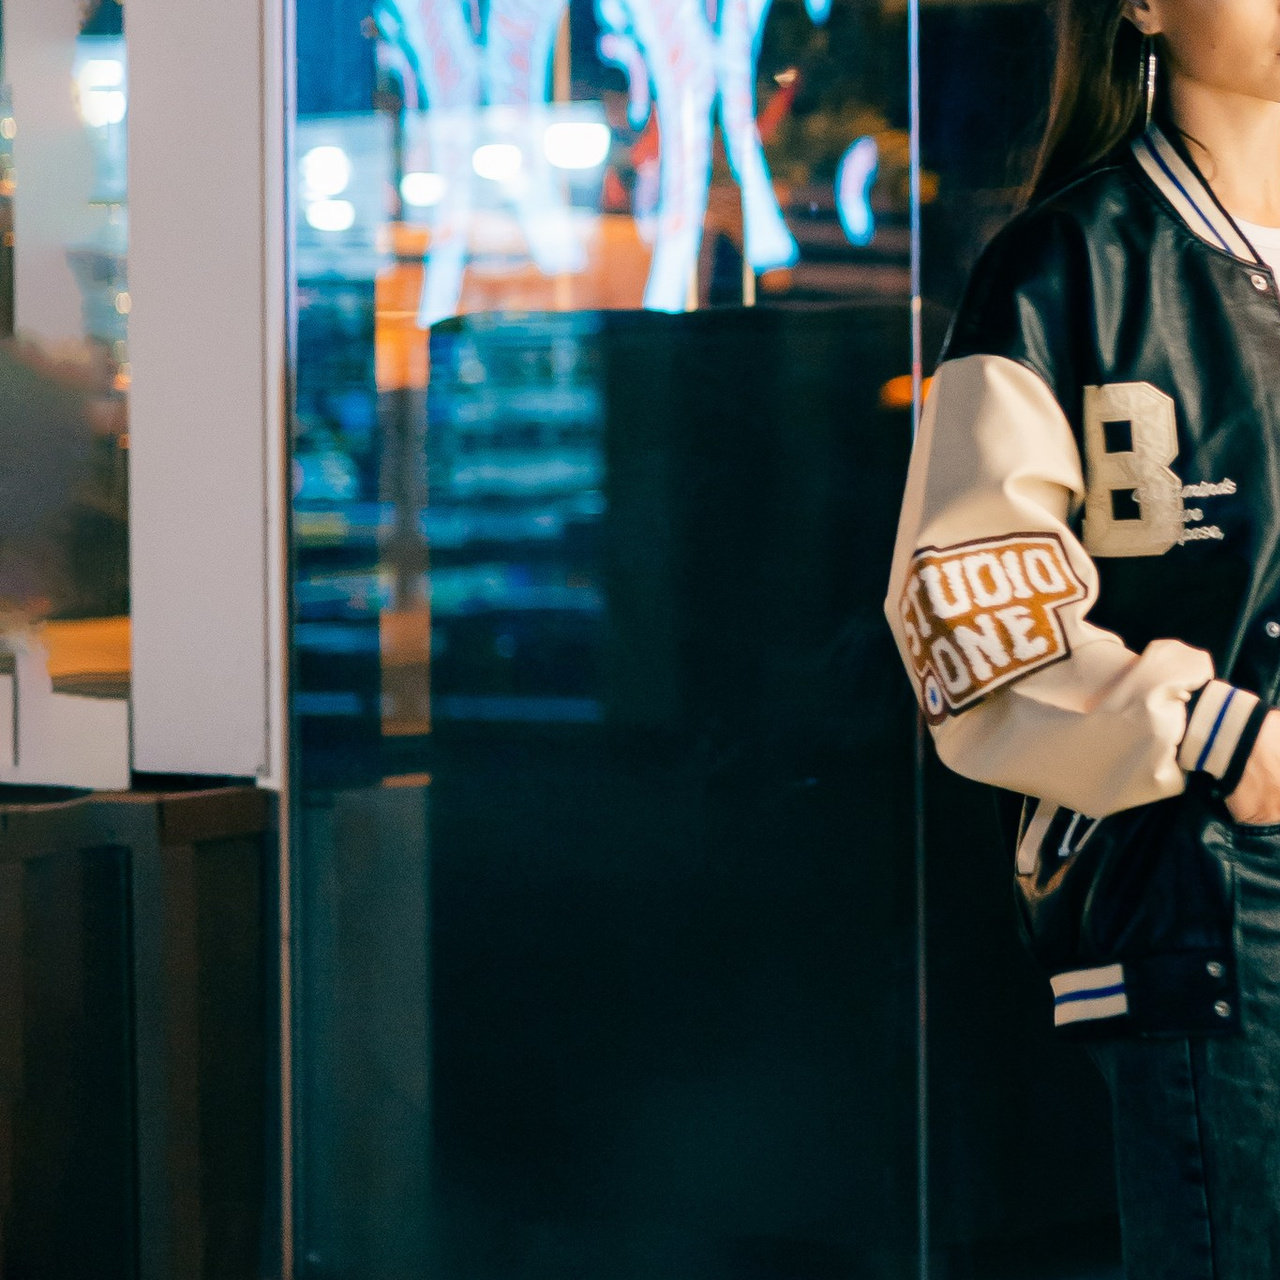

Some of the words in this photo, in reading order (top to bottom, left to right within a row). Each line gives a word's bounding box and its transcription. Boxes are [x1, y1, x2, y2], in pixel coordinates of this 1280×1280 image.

[1083, 381, 1184, 557] B
[901, 548, 1068, 657] STUDIO
[930, 605, 1050, 695] ONE
